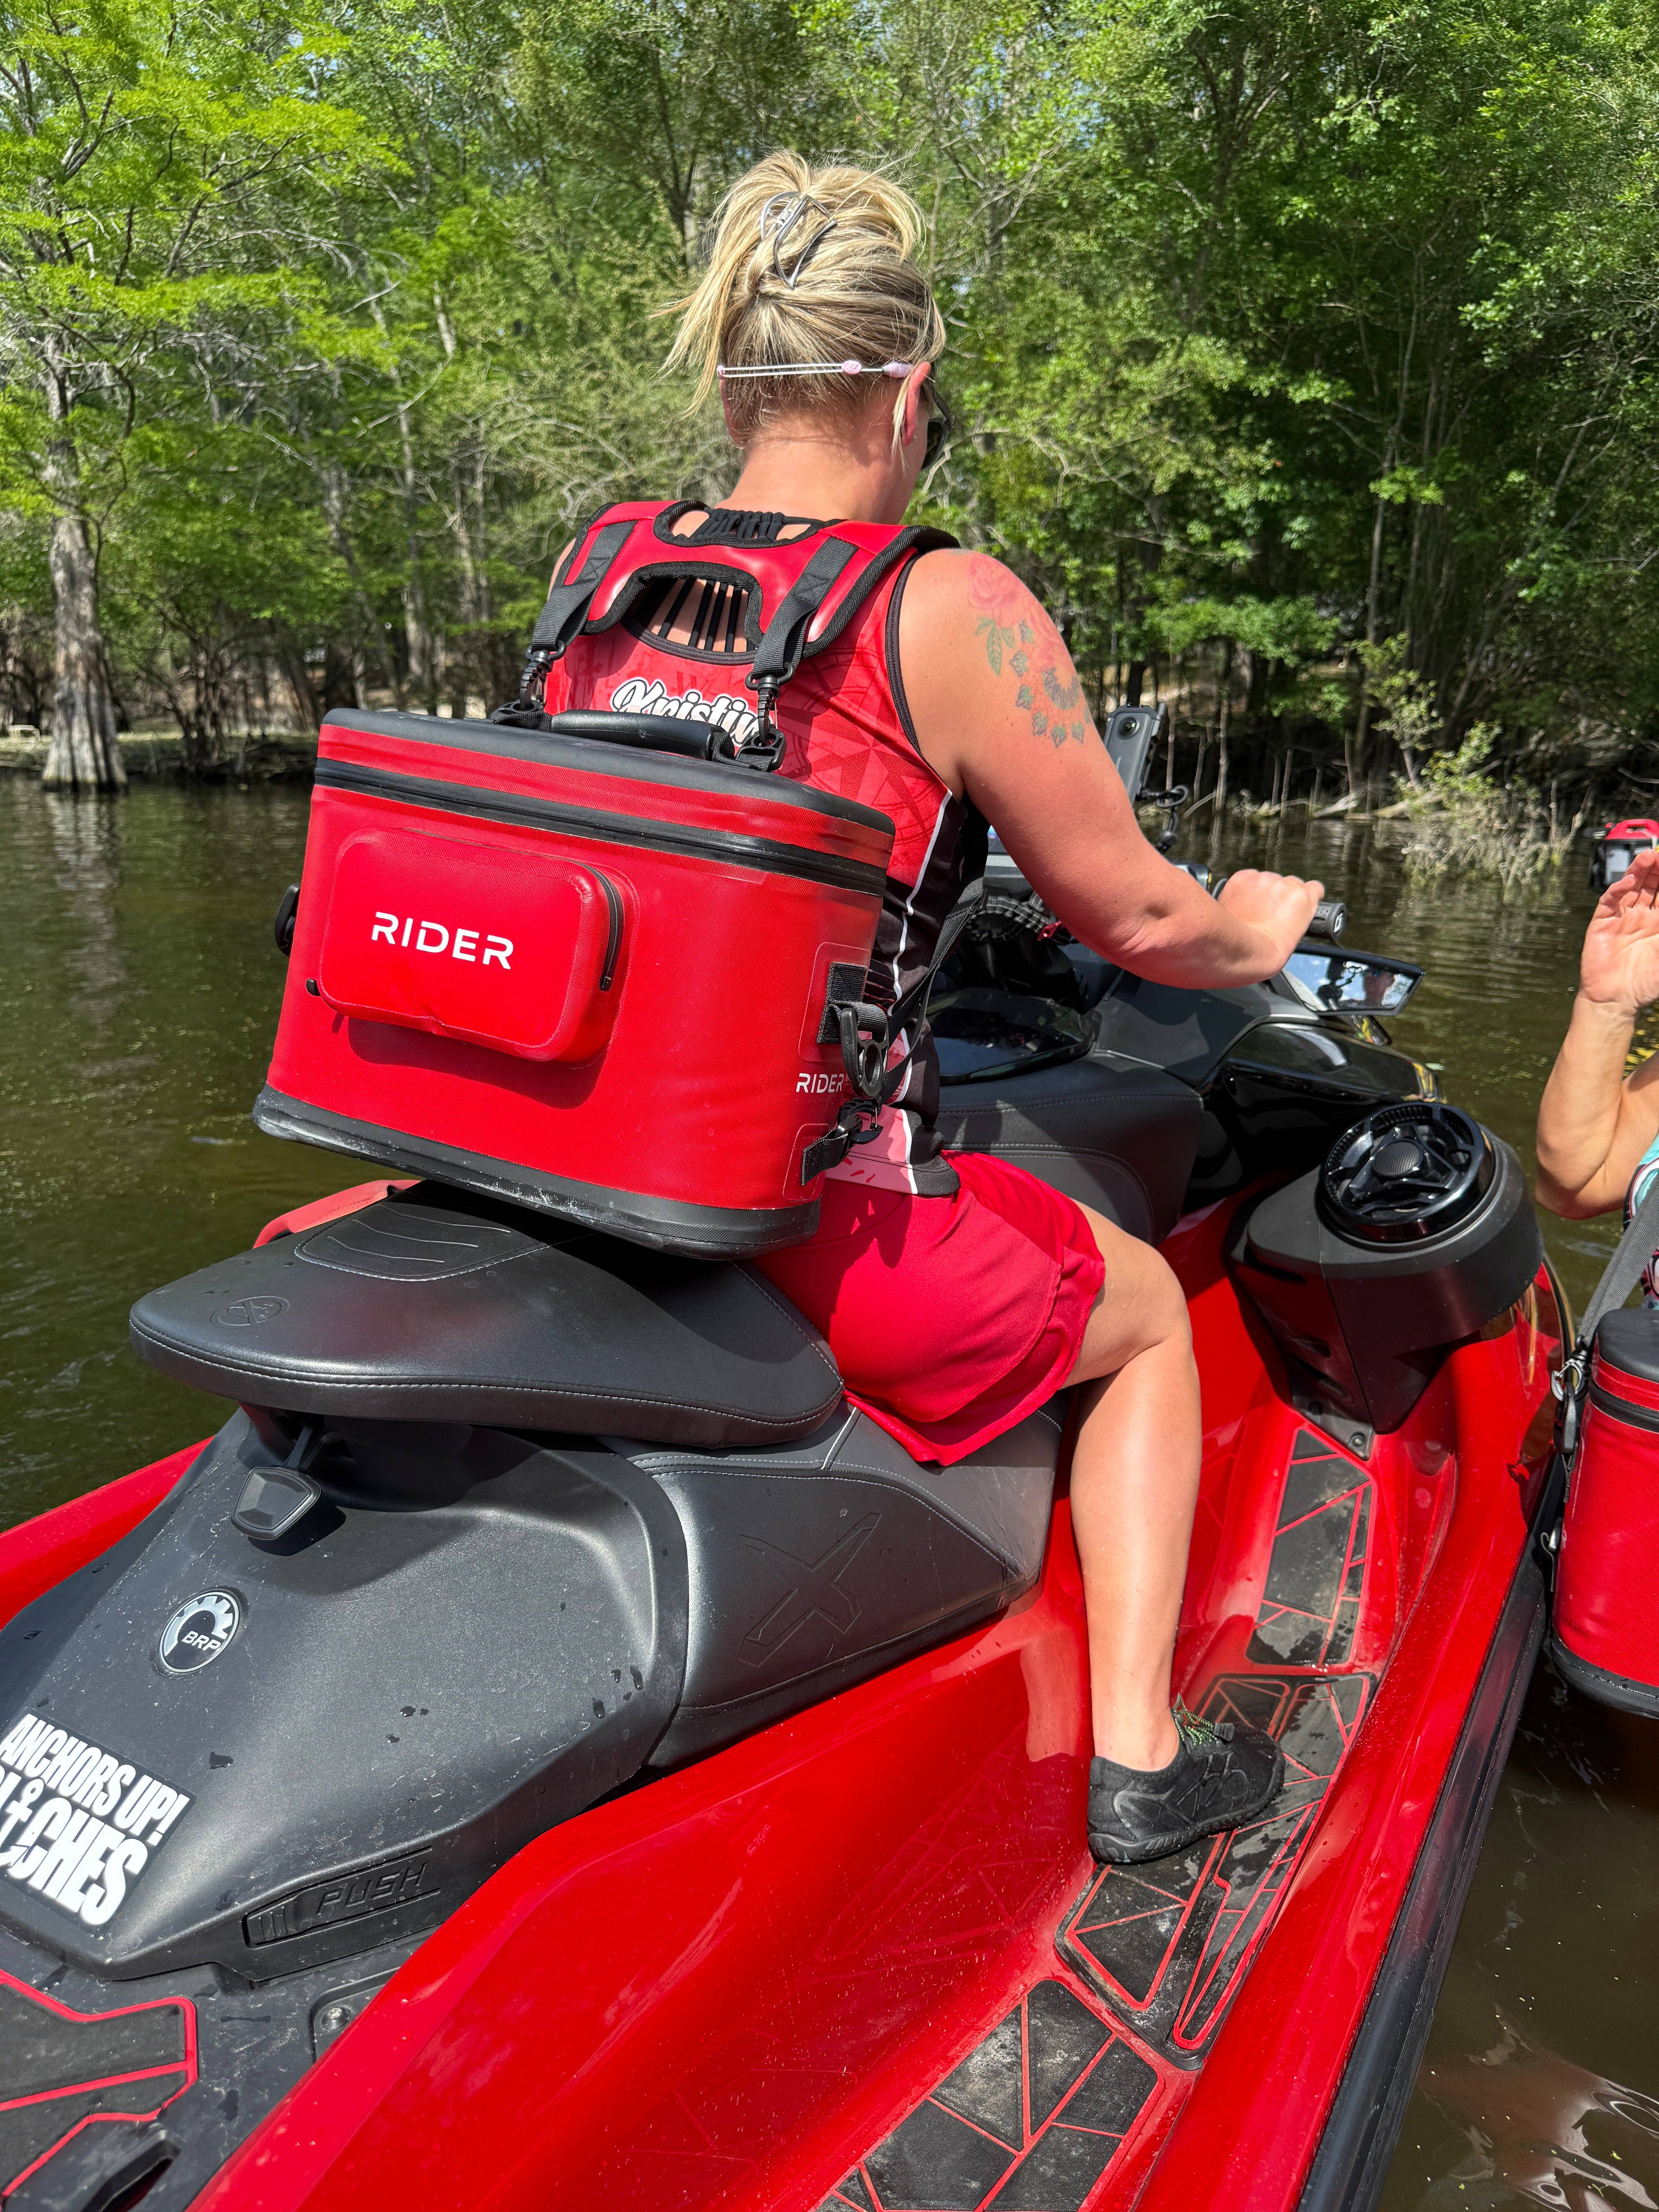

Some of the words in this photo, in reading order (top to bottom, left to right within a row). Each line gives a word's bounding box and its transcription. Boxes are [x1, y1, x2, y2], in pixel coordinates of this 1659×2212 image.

[371, 911, 514, 970] RIDER
[795, 1073, 845, 1094] RIDER
[181, 1630, 221, 1651] BRP
[0, 1714, 136, 1816] ANCHORS
[115, 1774, 190, 1846] UP!
[316, 1862, 426, 1916] PUSH
